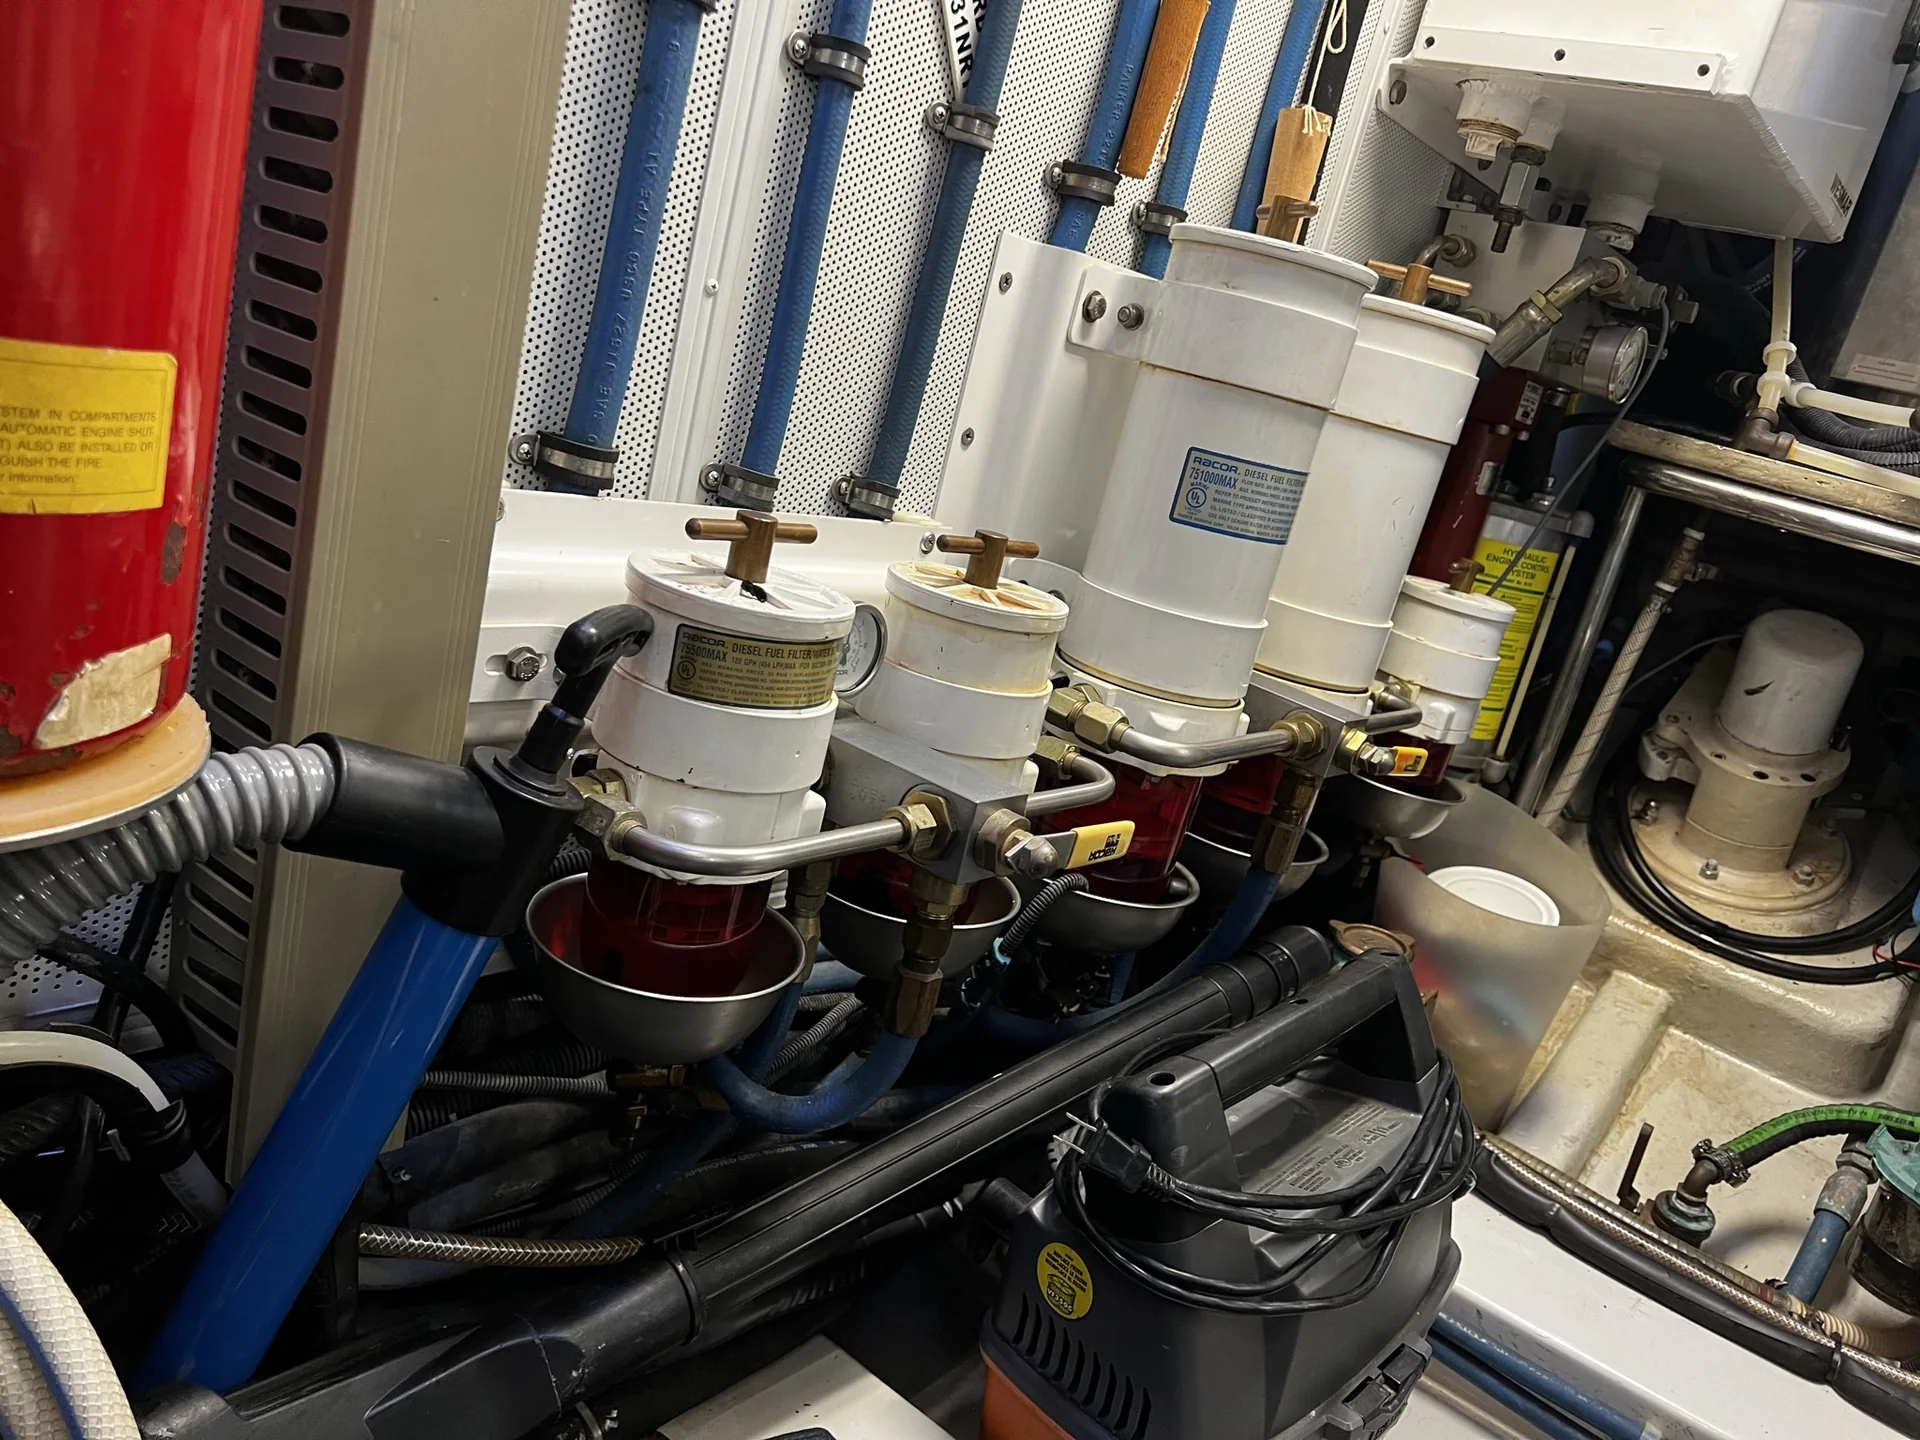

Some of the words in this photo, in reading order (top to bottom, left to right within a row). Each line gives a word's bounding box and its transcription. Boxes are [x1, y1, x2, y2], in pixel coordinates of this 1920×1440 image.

[1112, 64, 1134, 120] PARKER
[0, 407, 40, 420] STEM
[49, 410, 62, 421] IN
[70, 411, 157, 422] COMPARTMENTS
[1, 424, 75, 436] AUTOMATIC
[82, 427, 124, 437] ENGINE
[17, 440, 53, 451] ALSO
[59, 442, 75, 452] BE
[81, 442, 137, 454] INSTALLED
[140, 441, 153, 452] OR
[47, 457, 70, 468] THE
[1189, 467, 1239, 490] 751000MAX
[1244, 469, 1269, 481] DIESEL
[1271, 475, 1285, 485] FUEL
[1191, 491, 1200, 505] UL
[1215, 489, 1232, 497] REFER
[1218, 506, 1237, 516] LISTED
[1233, 501, 1245, 509] TYPE
[680, 641, 728, 663] 75500MAX
[732, 643, 763, 657] DIESEL
[765, 647, 785, 659] FUEL
[681, 664, 691, 677] UL
[684, 1157, 737, 1178] APPROVED
